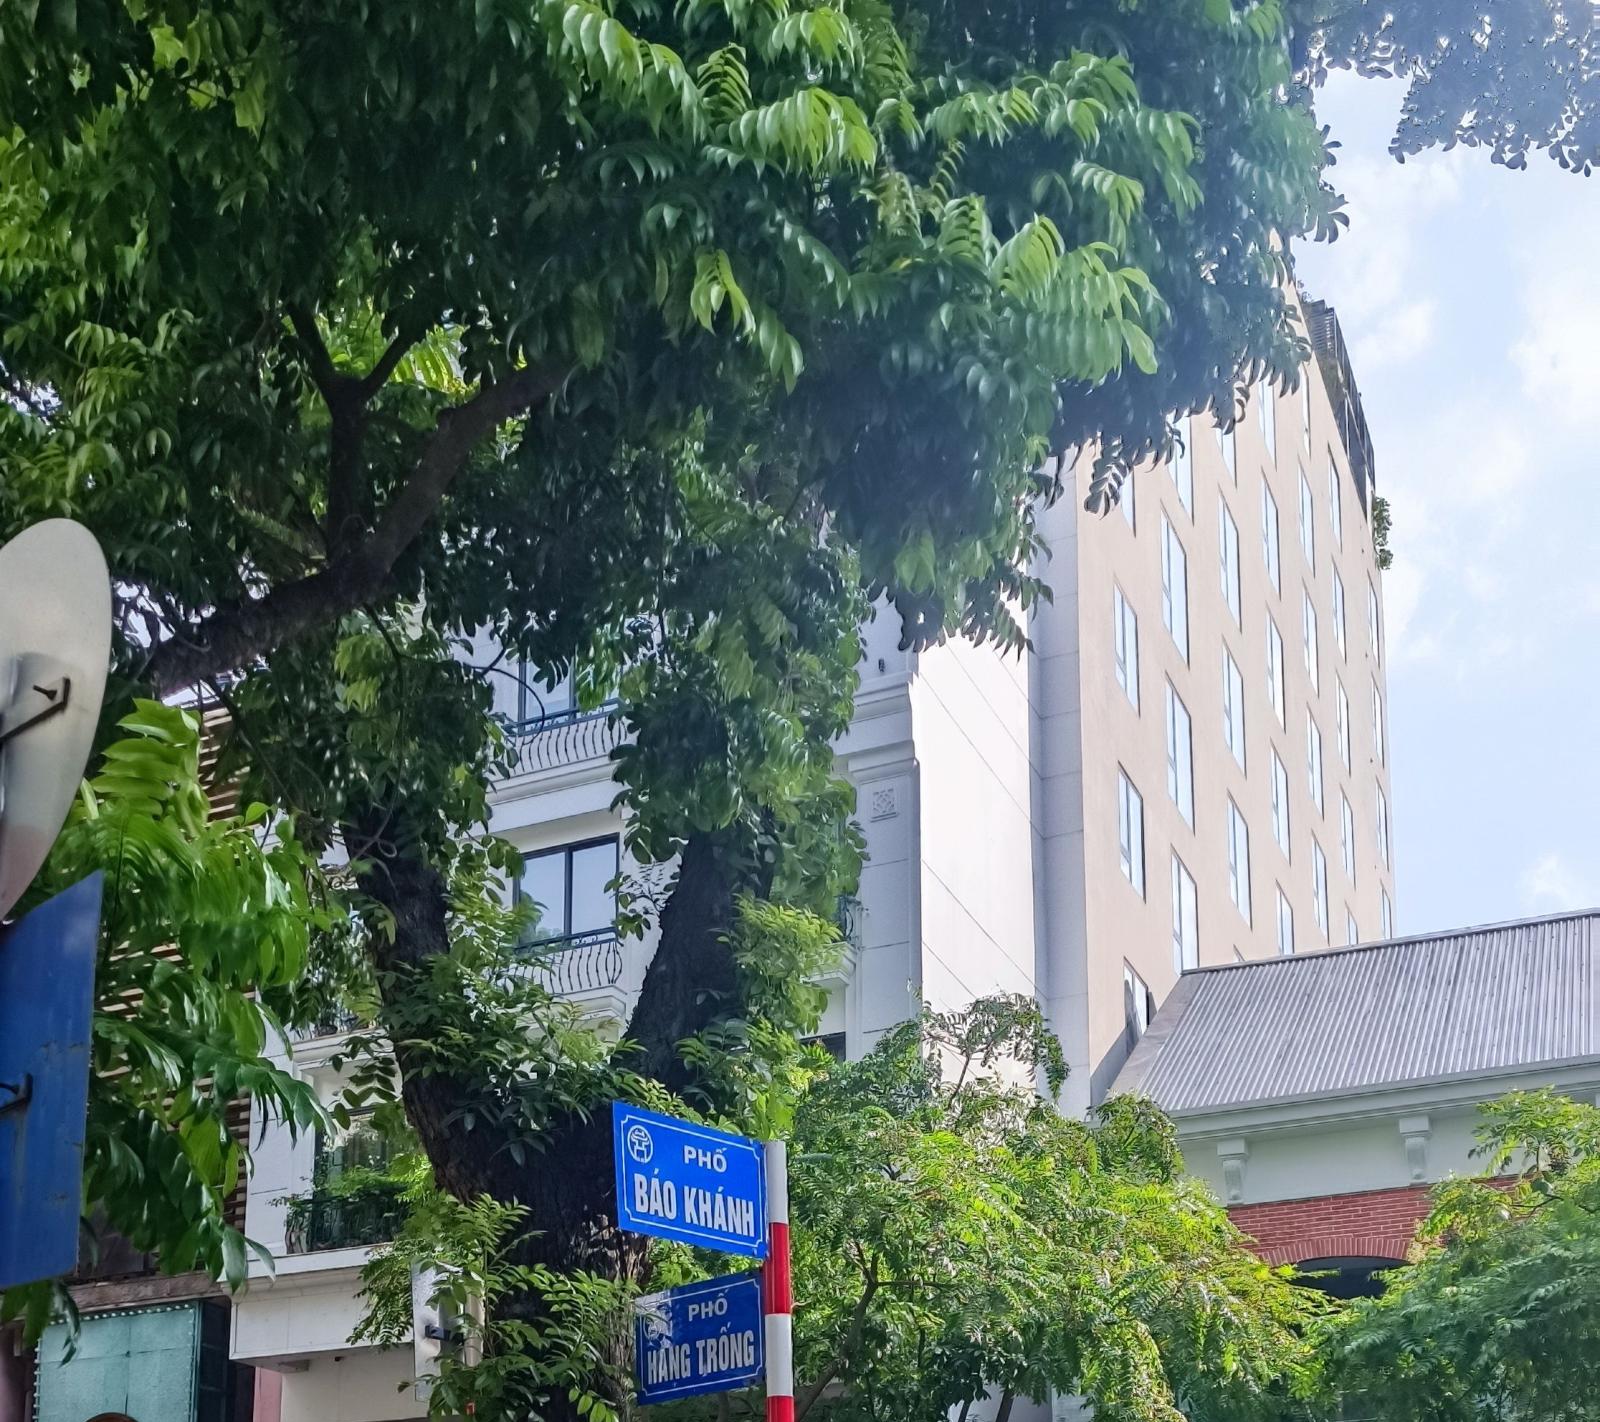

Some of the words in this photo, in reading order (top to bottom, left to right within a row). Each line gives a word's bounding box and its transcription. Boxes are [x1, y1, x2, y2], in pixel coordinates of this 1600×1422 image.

[684, 1147, 727, 1173] PHỐ
[634, 1167, 677, 1220] BÁO
[683, 1186, 755, 1238] KHÁNH
[688, 1288, 728, 1322] PHỐ
[696, 1321, 755, 1377] TRỐNG
